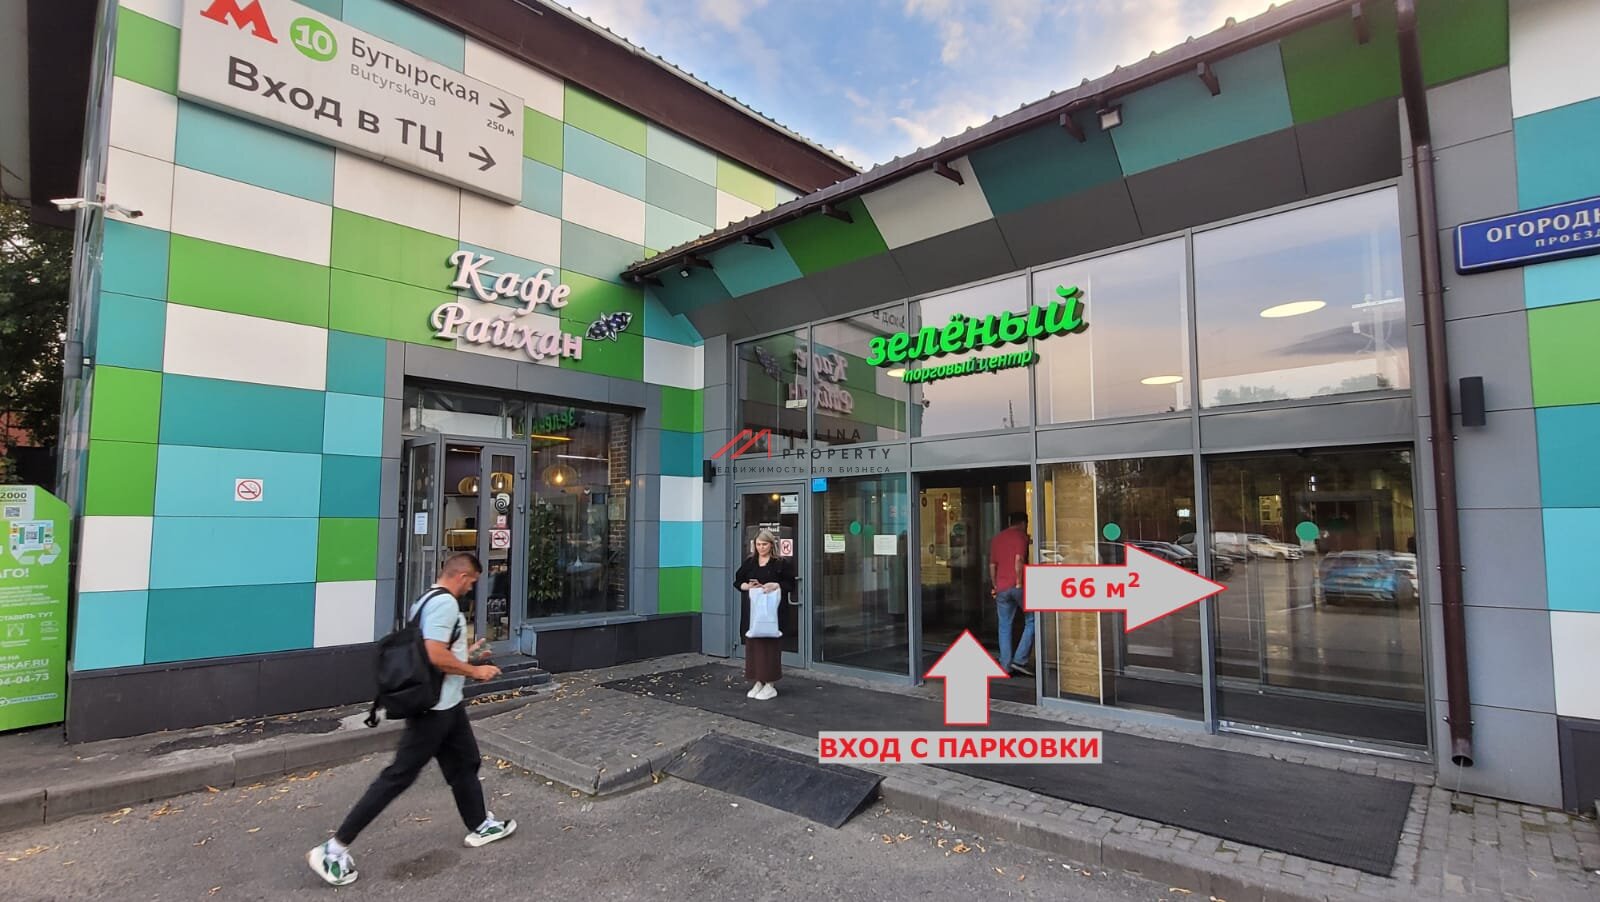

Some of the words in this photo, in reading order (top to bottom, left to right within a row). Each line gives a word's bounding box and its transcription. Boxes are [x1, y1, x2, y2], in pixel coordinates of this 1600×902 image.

[295, 25, 333, 55] 10
[350, 63, 436, 106] Butyrskaya
[351, 37, 480, 105] Бутырская
[228, 56, 343, 127] Вход
[358, 109, 380, 134] в
[394, 117, 444, 162] ТЦ
[486, 119, 504, 133] 250
[507, 128, 515, 136] м
[449, 250, 571, 315] Кафе
[431, 302, 583, 360] Райхан
[866, 284, 1083, 367] зелёный
[902, 356, 976, 383] торговый
[979, 350, 1033, 373] центр
